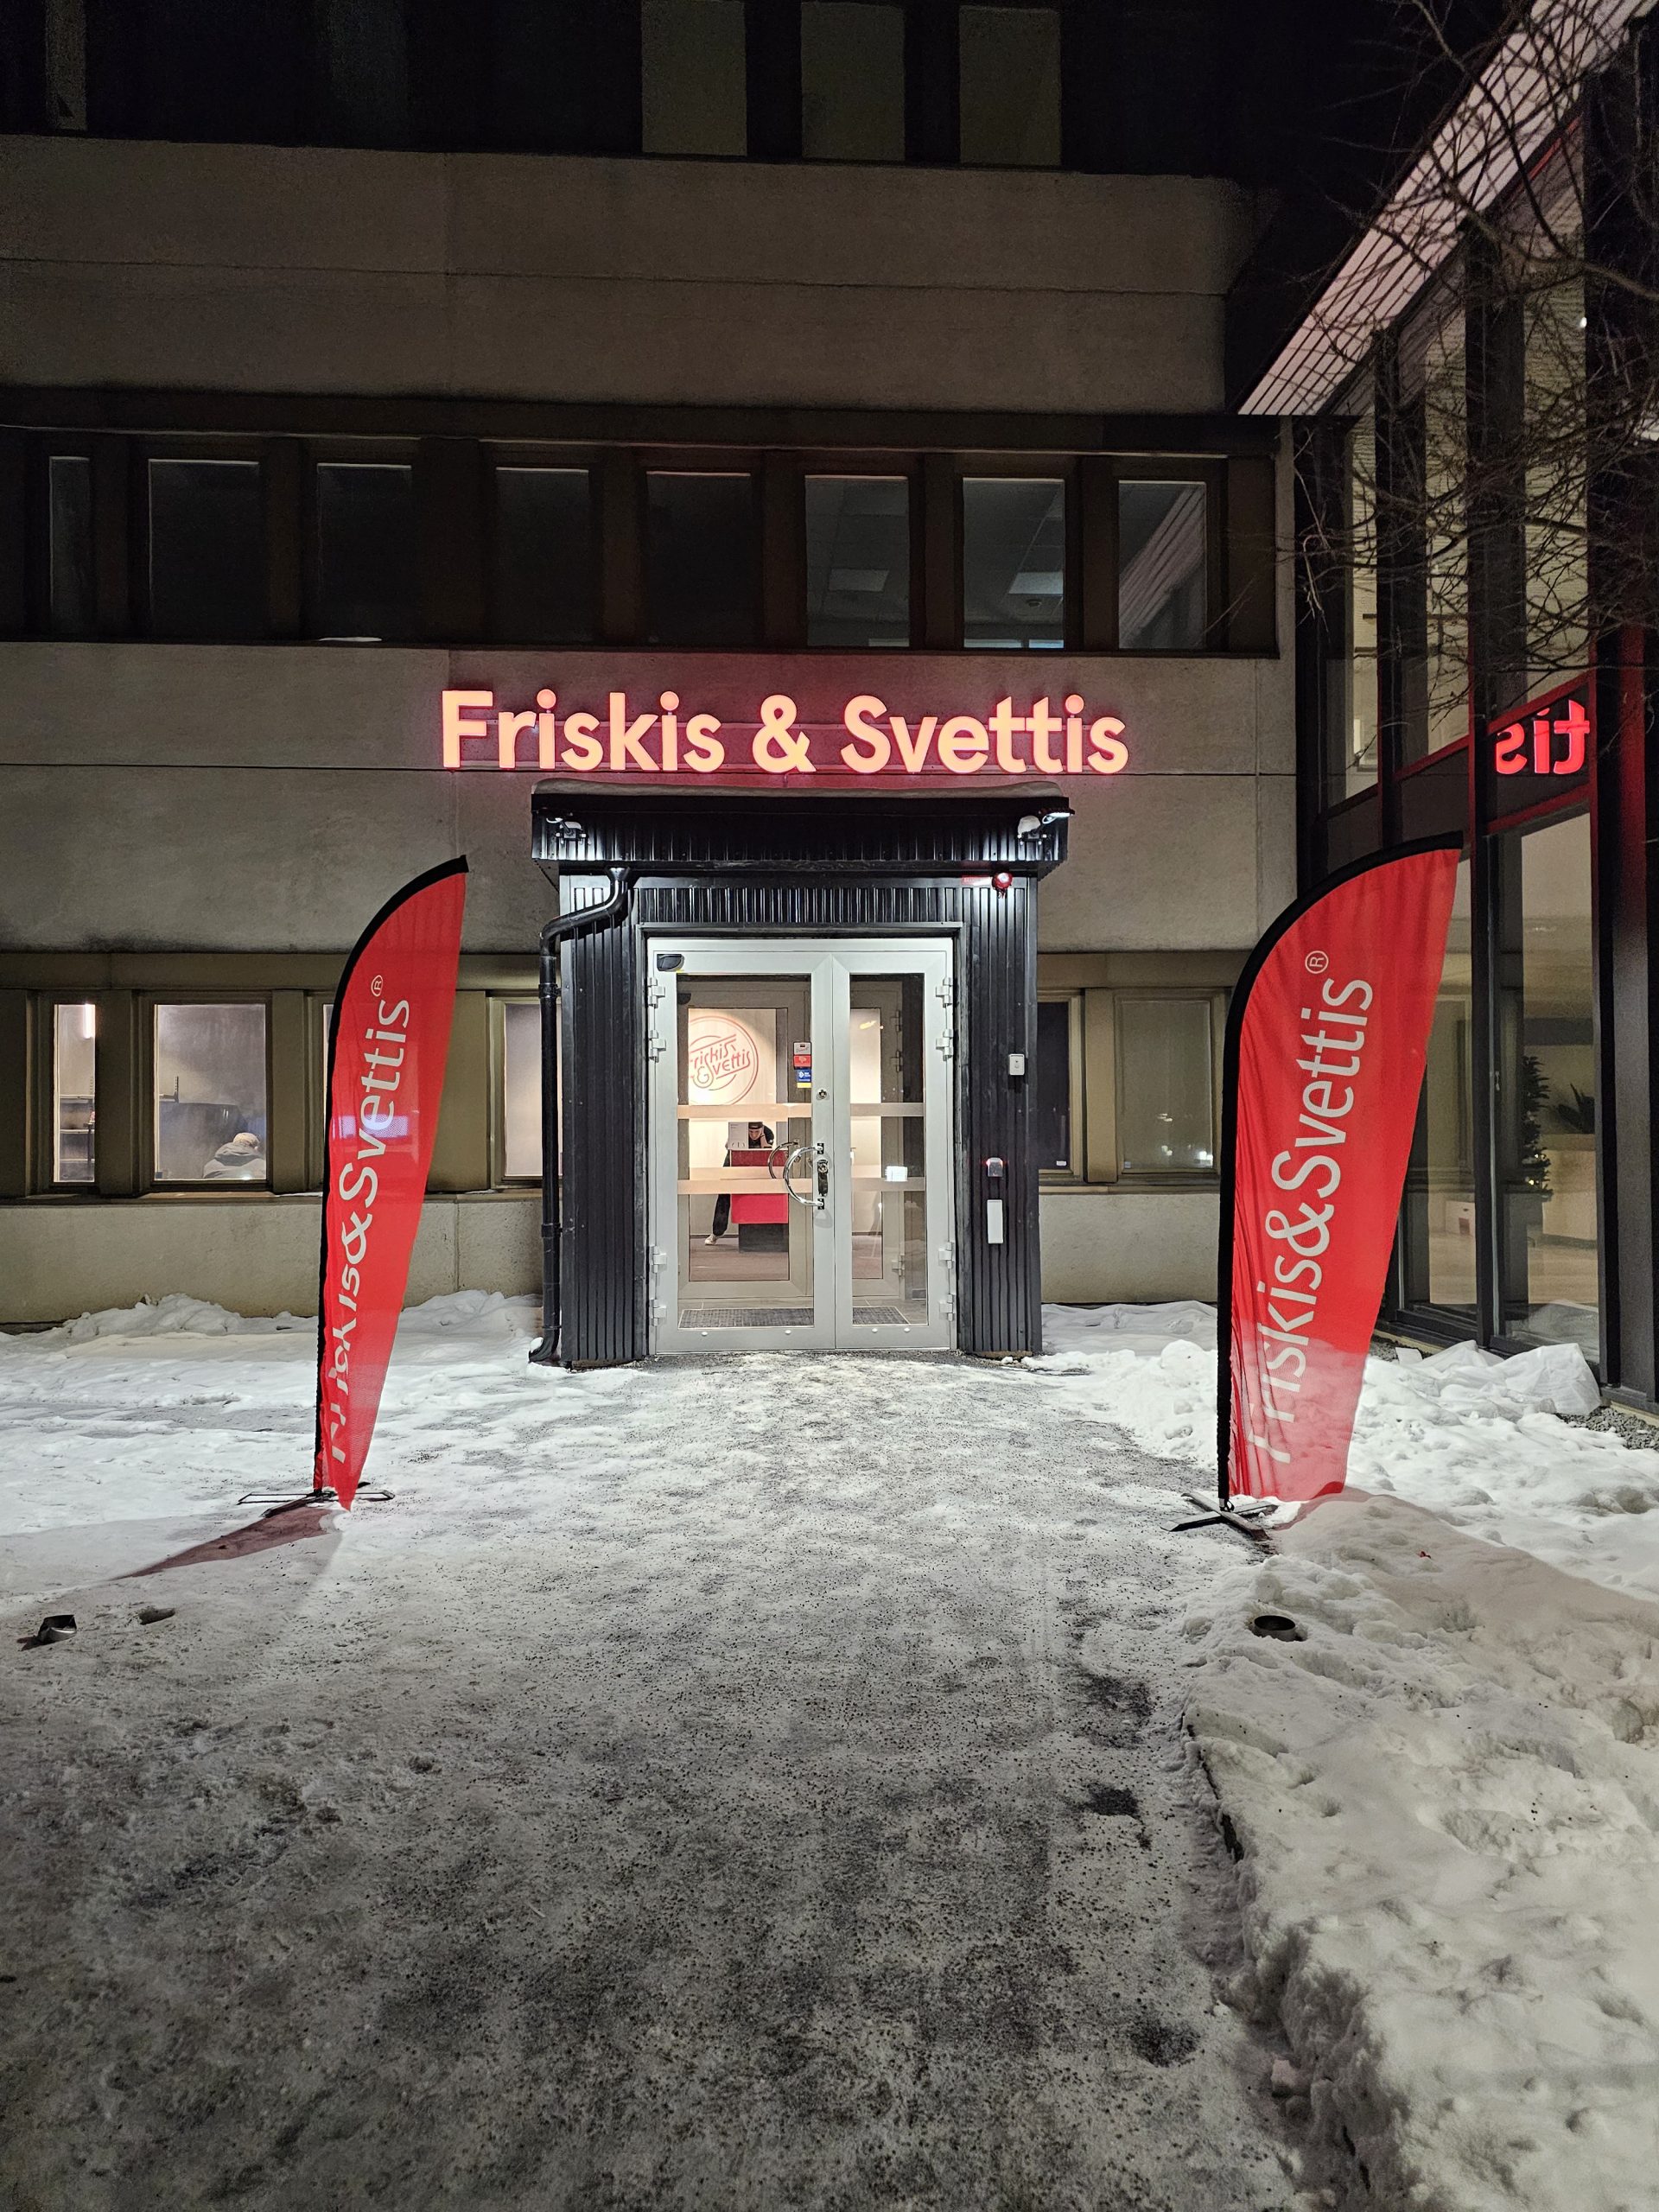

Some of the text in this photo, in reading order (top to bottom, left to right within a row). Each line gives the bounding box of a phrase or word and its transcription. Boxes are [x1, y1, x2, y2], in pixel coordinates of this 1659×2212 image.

[442, 689, 1129, 774] Friskis & Svettis
[690, 1036, 737, 1070] riskis
